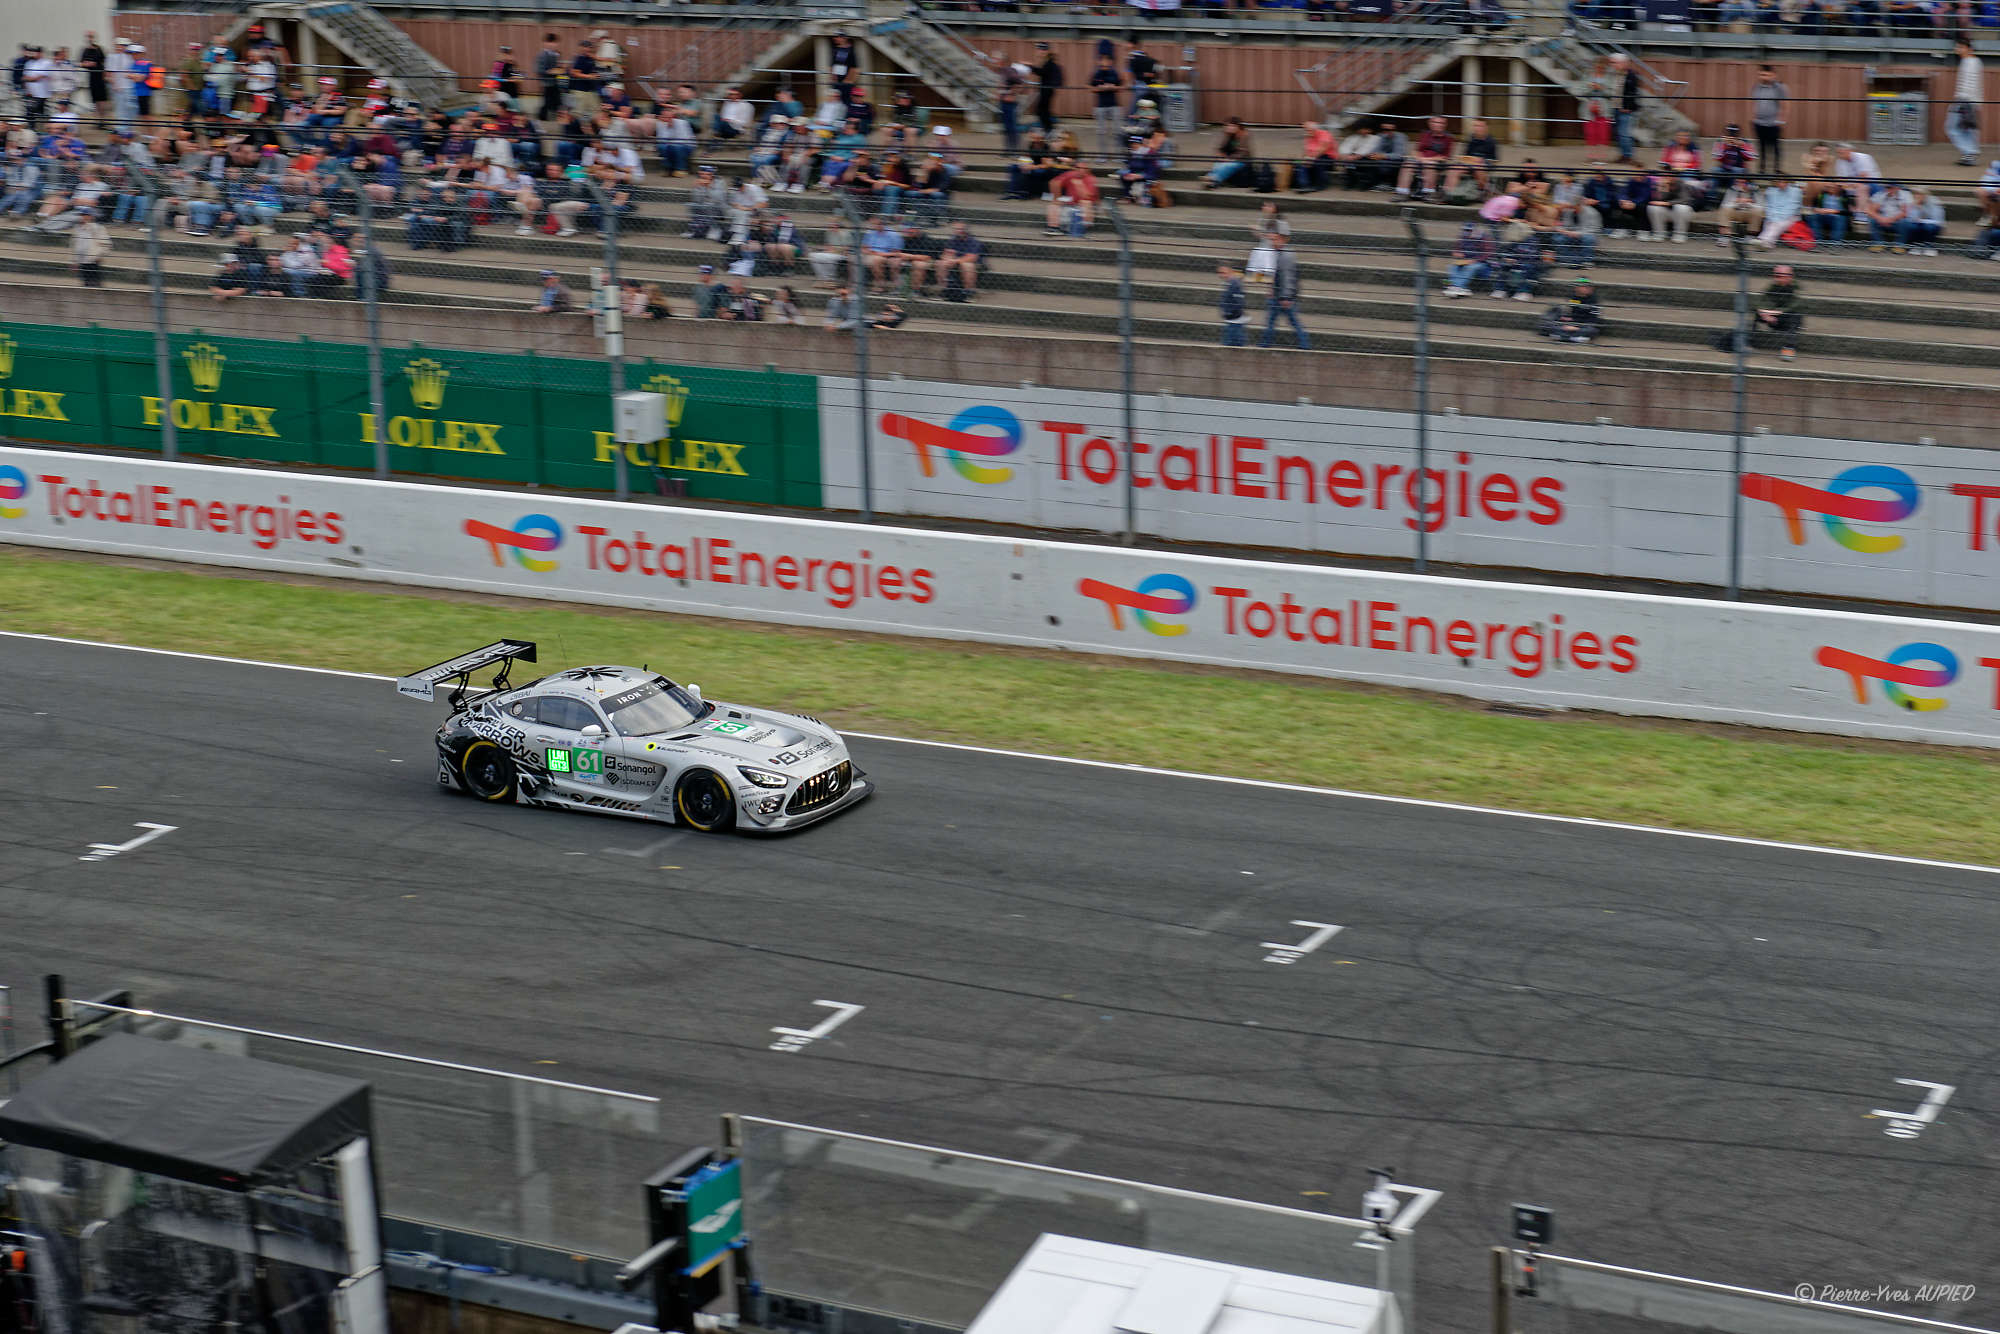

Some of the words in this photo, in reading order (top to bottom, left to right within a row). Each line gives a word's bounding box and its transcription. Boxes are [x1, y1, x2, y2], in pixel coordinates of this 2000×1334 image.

[1044, 422, 1564, 533] TotalEnergies
[40, 474, 344, 551] TotalEnergies
[577, 525, 934, 609] TotalEnergies
[1213, 587, 1638, 679] TotalEnergies
[617, 691, 643, 705] IRON
[719, 722, 746, 734] 61
[551, 759, 567, 770] GT3
[576, 750, 600, 772] 61
[617, 762, 657, 776] Sonangol
[743, 799, 761, 809] IWC
